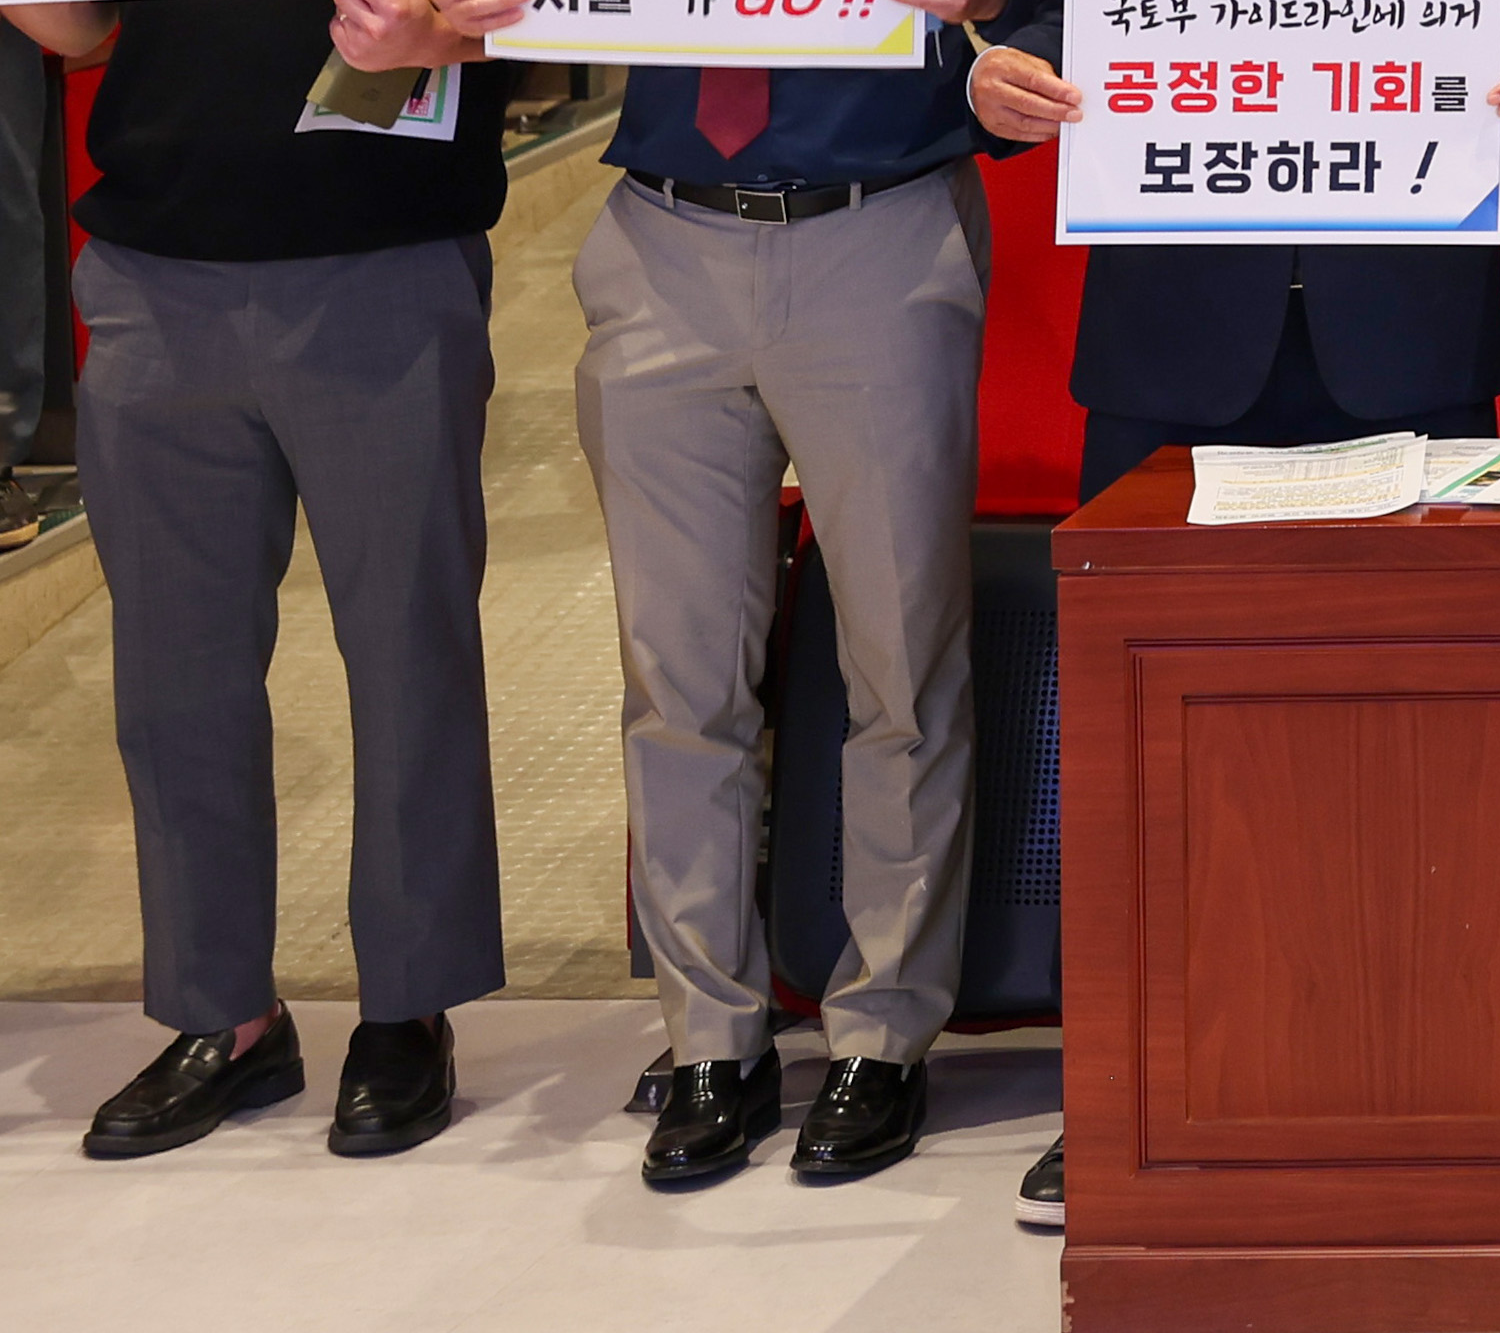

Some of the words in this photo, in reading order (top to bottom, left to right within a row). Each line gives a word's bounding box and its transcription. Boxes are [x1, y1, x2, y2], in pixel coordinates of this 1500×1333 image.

[1420, 0, 1480, 29] 의거
[1104, 61, 1284, 113] 공정한
[1313, 61, 1468, 113] 기회를
[1140, 141, 1381, 193] 보장하라
